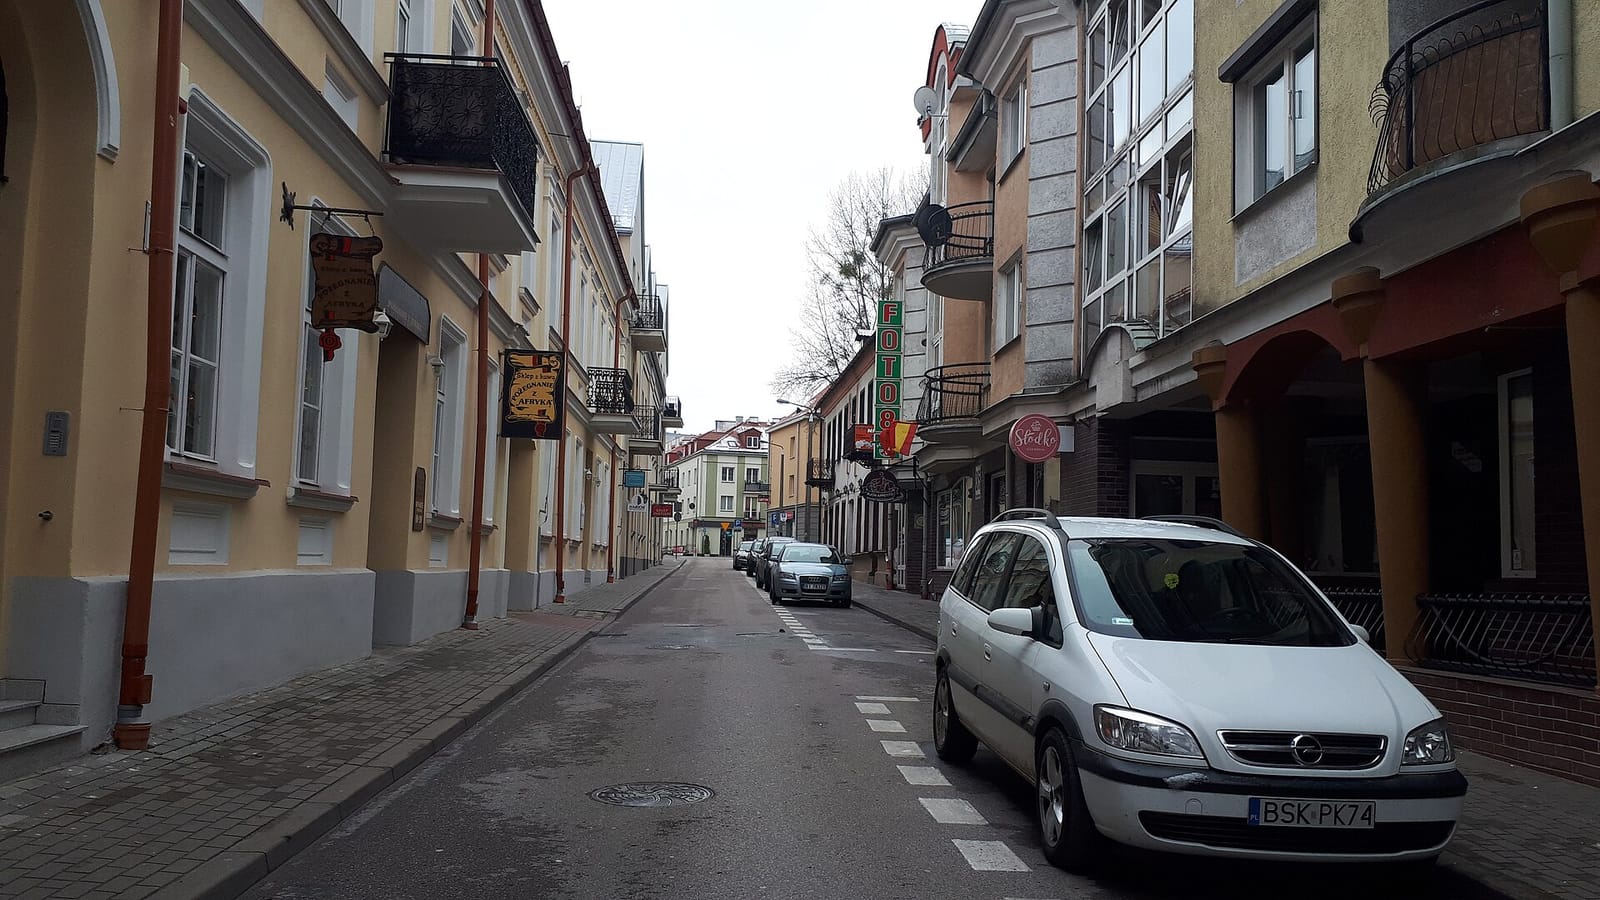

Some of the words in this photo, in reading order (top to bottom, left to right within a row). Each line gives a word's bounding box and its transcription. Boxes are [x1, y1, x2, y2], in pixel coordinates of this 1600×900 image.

[517, 372, 533, 380] Sklep
[511, 381, 553, 402] POŻEGNANIE
[1264, 802, 1312, 825] BSK
[1318, 803, 1373, 826] PK74
